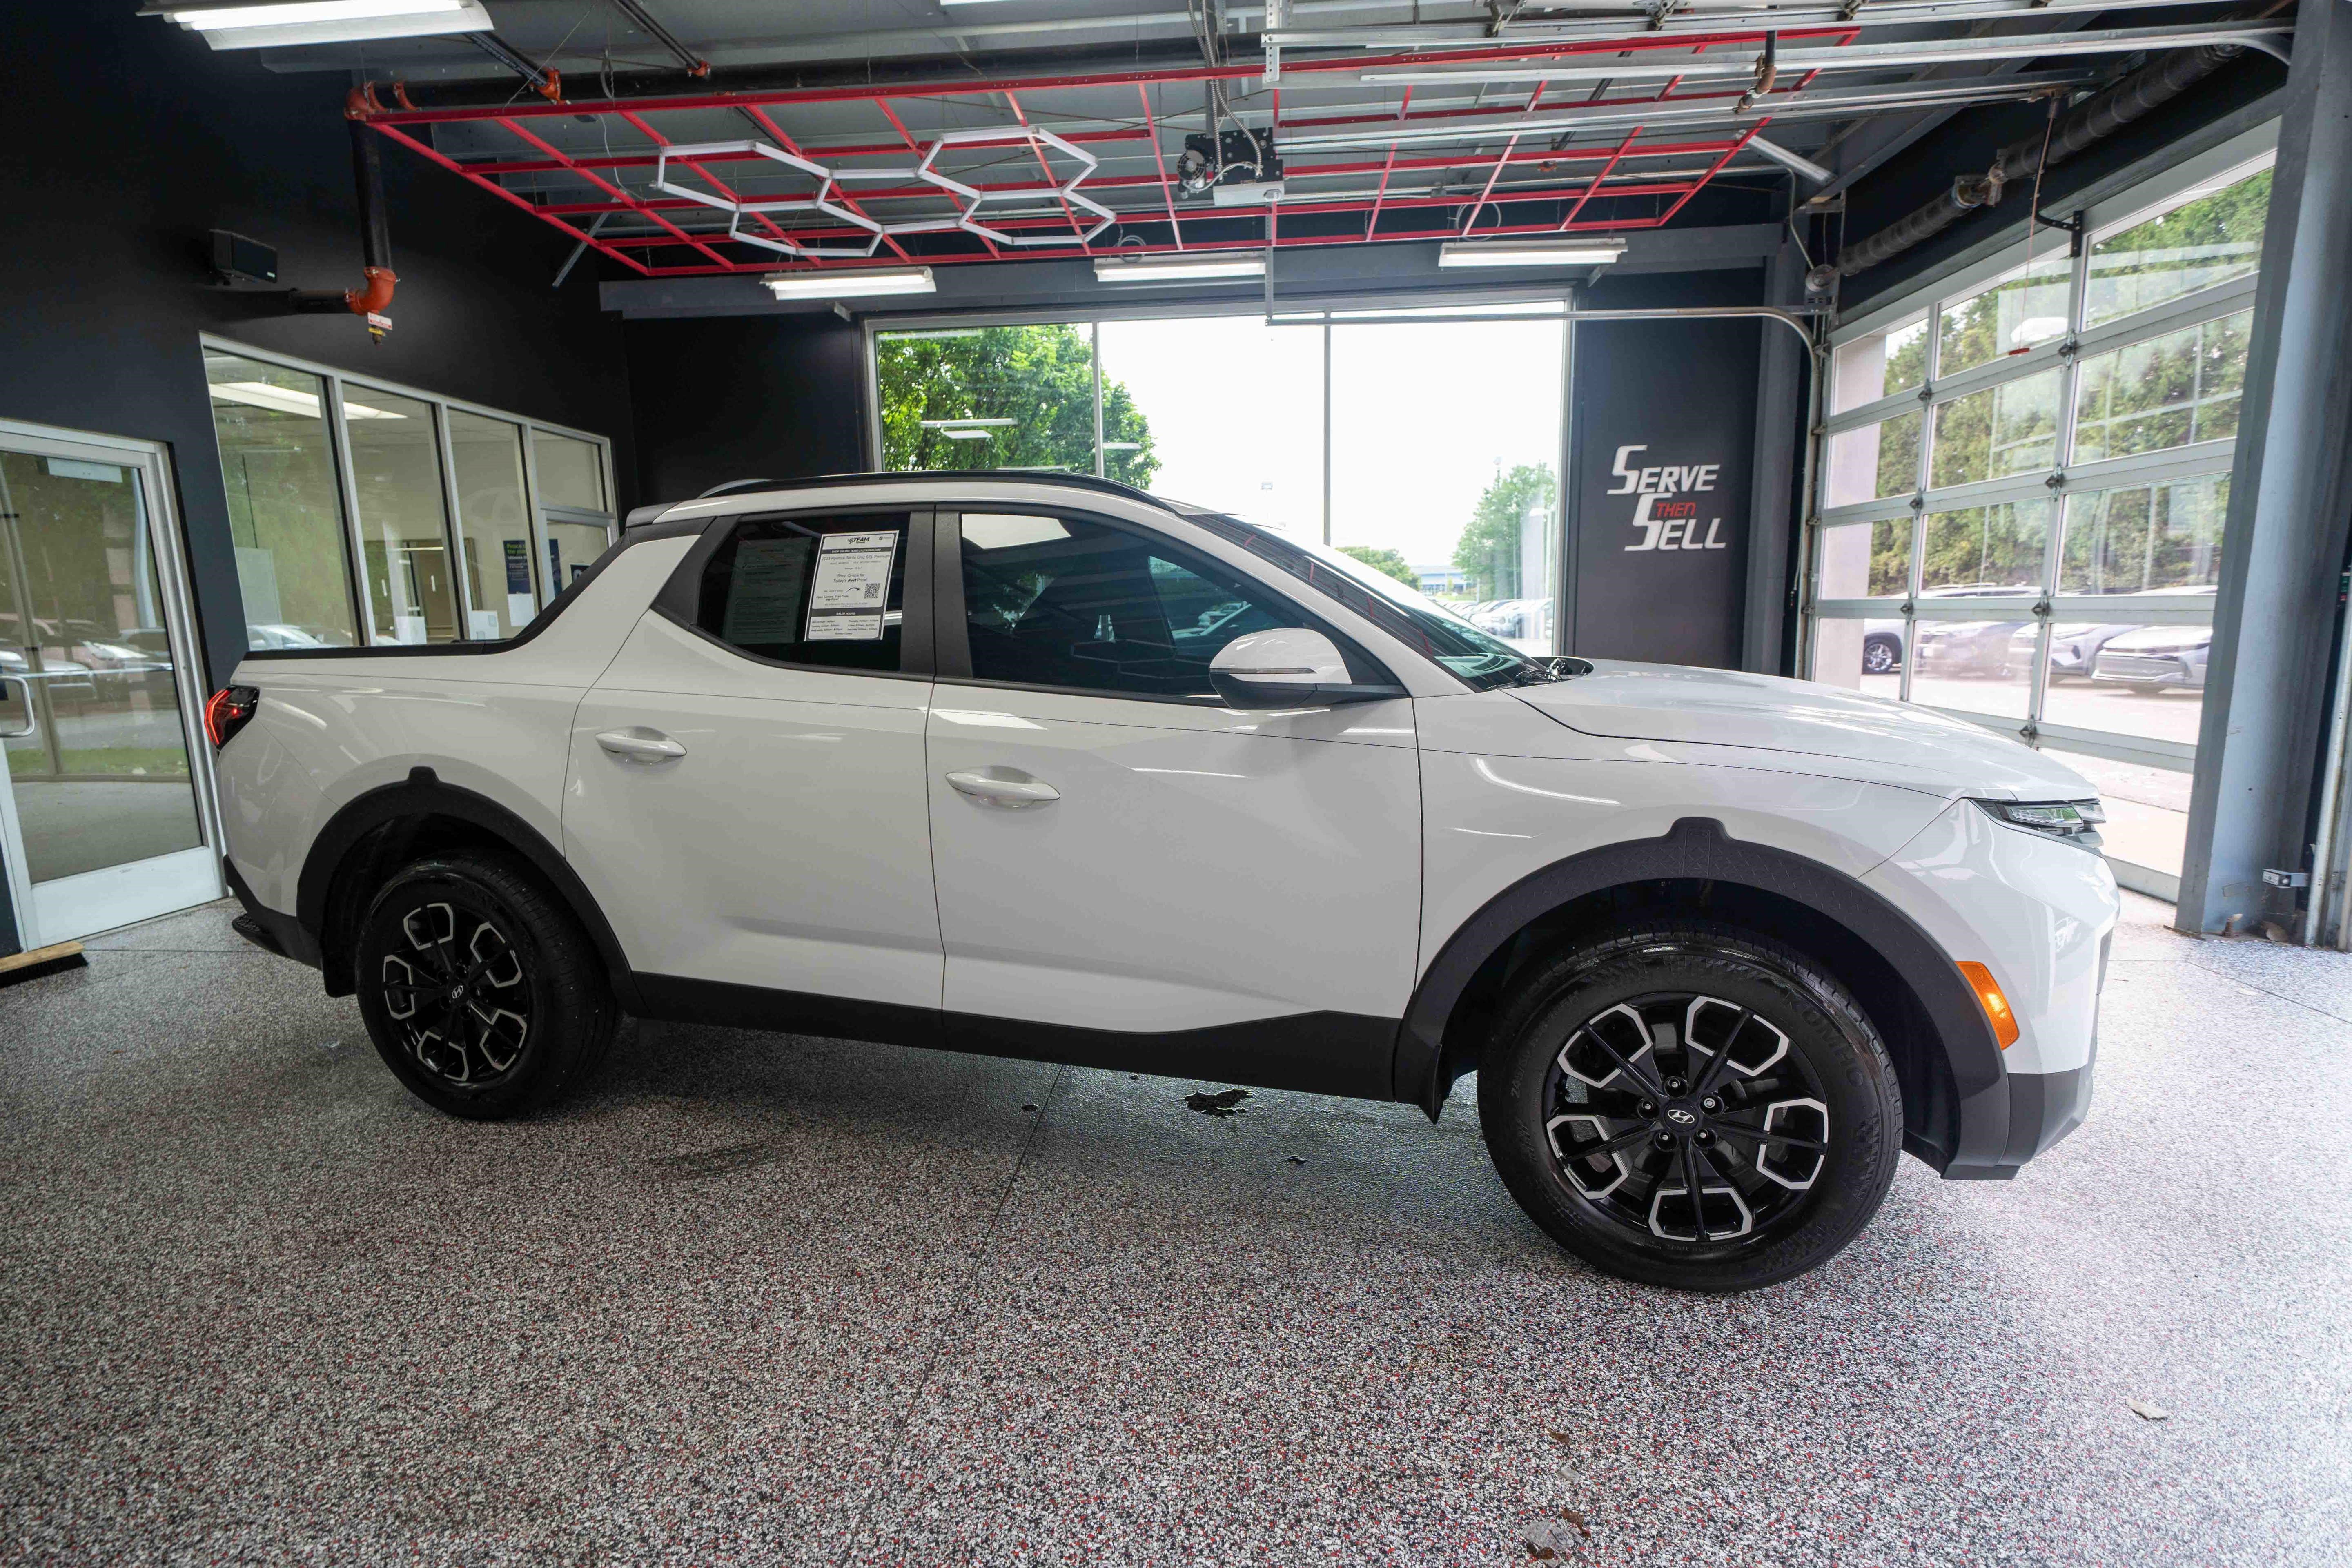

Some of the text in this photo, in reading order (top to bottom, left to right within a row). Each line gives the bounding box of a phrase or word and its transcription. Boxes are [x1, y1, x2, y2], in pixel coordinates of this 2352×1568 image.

[1607, 444, 1720, 495] SERVE
[1624, 492, 1726, 552] SELL
[1656, 501, 1697, 517] THEN
